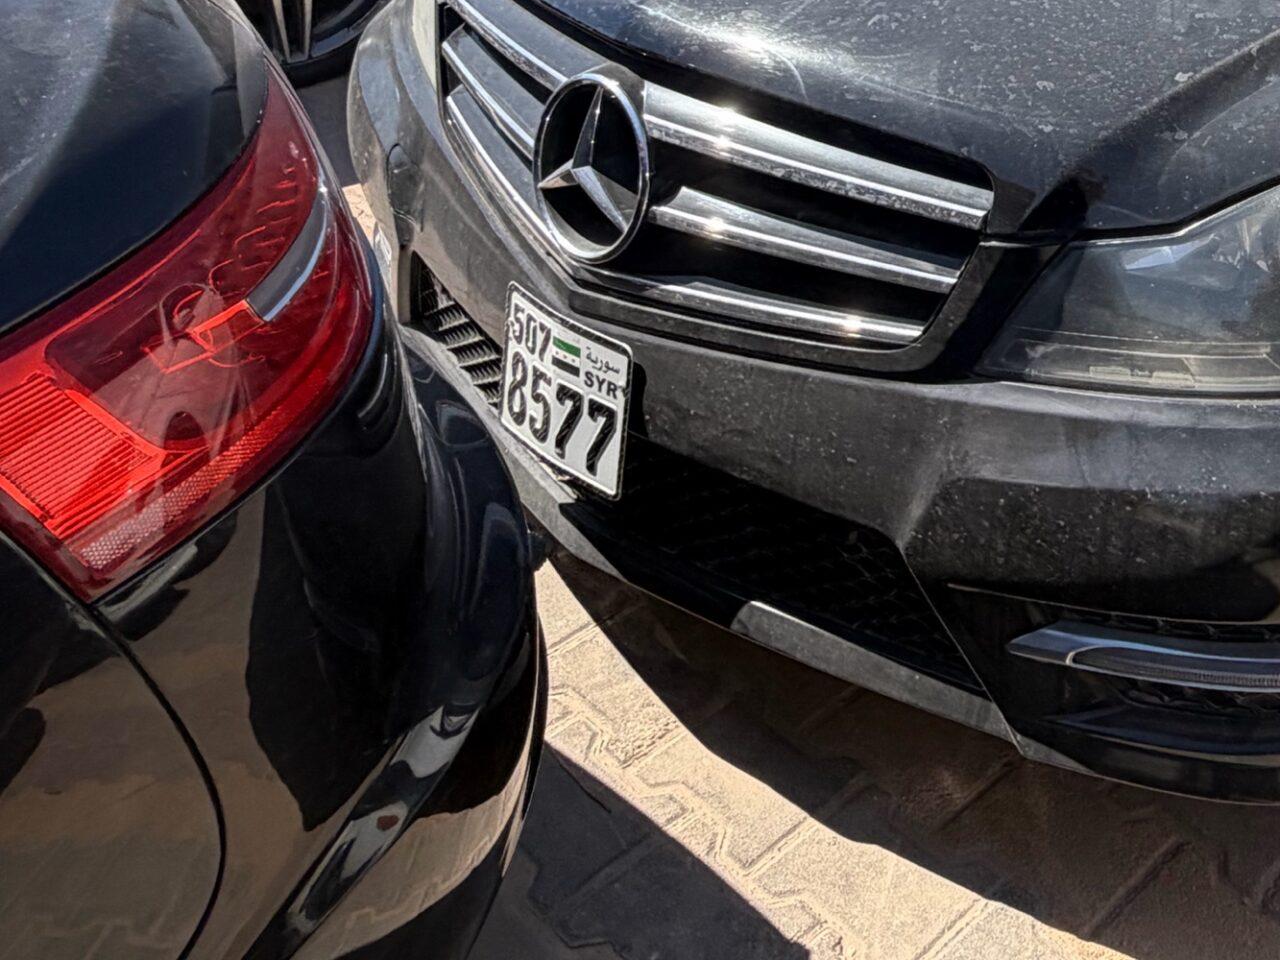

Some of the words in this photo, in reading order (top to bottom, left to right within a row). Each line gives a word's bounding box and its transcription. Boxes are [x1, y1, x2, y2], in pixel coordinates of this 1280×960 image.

[512, 302, 552, 363] 507
[585, 345, 621, 375] سورية
[584, 370, 618, 400] SYR
[507, 350, 618, 477] 8577
